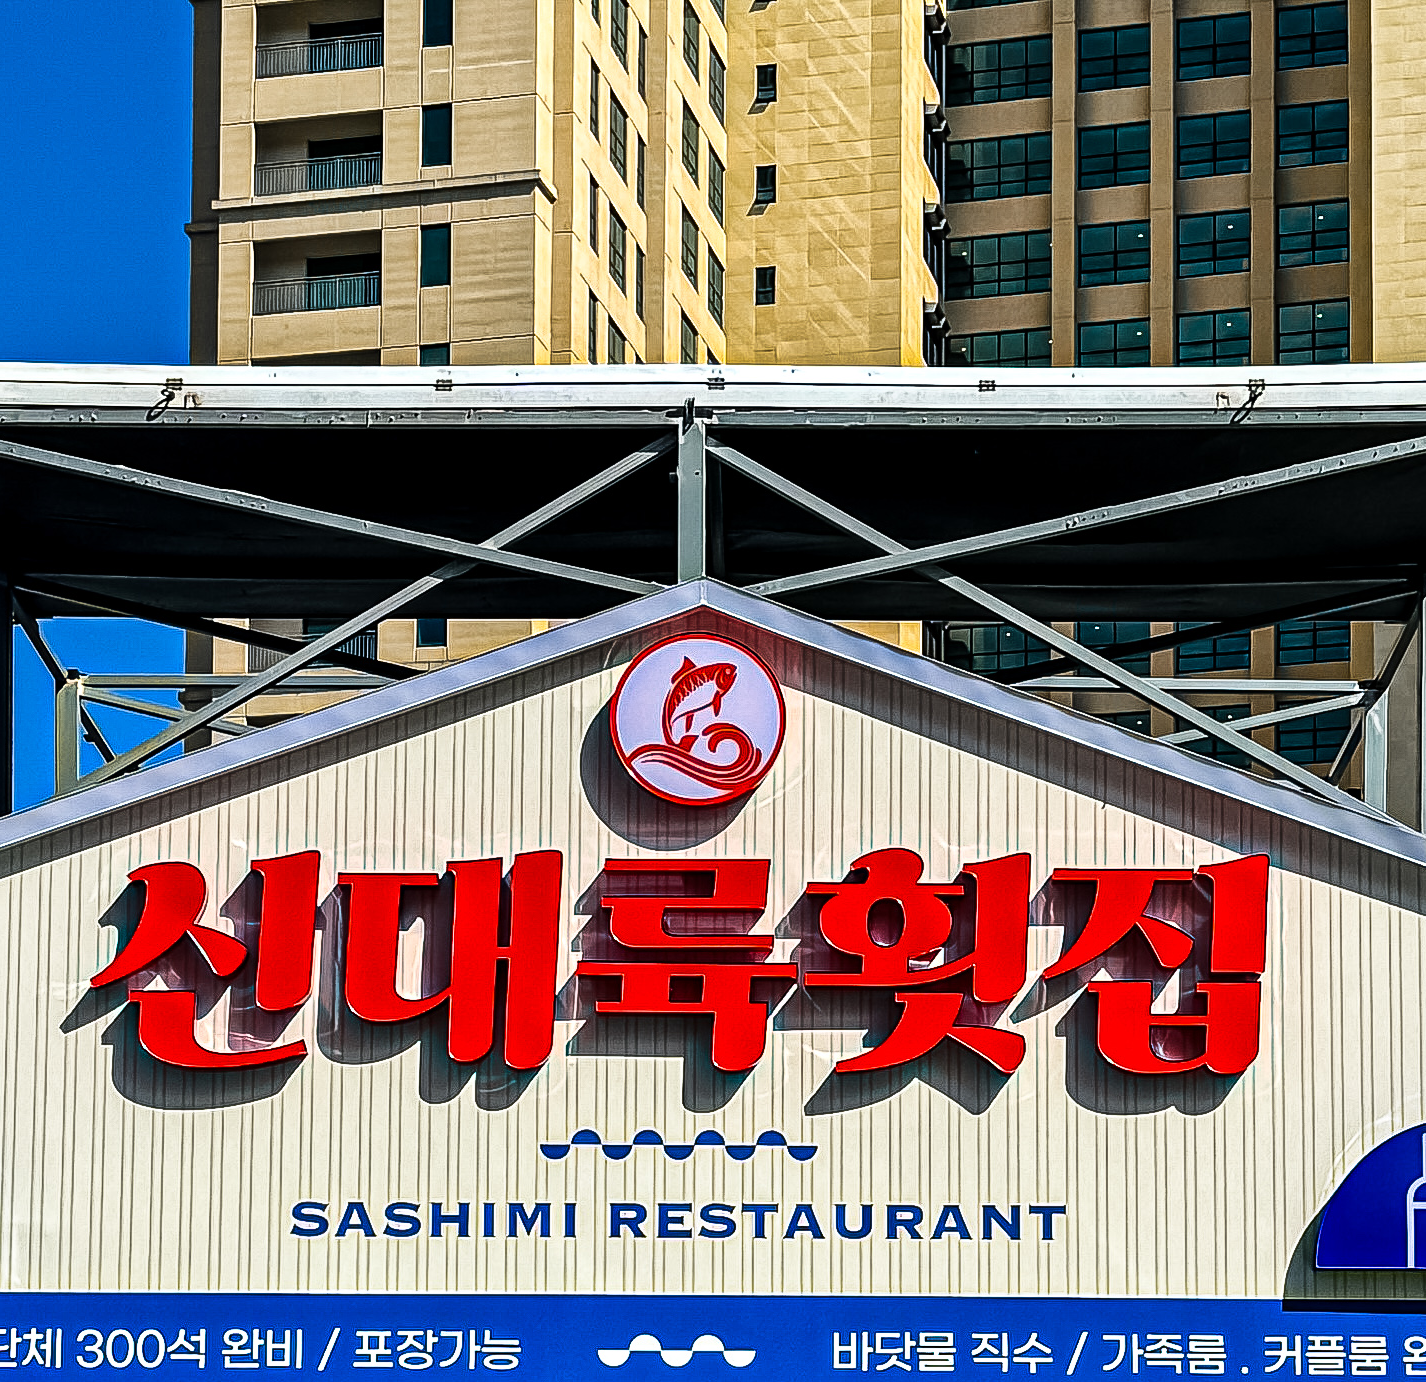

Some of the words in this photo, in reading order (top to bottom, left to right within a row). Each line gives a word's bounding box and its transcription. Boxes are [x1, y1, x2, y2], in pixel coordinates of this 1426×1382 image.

[89, 848, 1271, 1075] 신대륙횟집
[290, 1202, 577, 1238] SASHIMI
[609, 1204, 1067, 1240] RESTAURANT
[76, 1328, 206, 1369] 300석
[221, 1328, 303, 1369] 완비
[352, 1329, 522, 1370] 포장가능
[833, 1331, 957, 1372] 바닷물
[971, 1332, 1054, 1374] 직수
[1102, 1333, 1227, 1375] 가족룸
[1264, 1334, 1390, 1376] 커플룸
